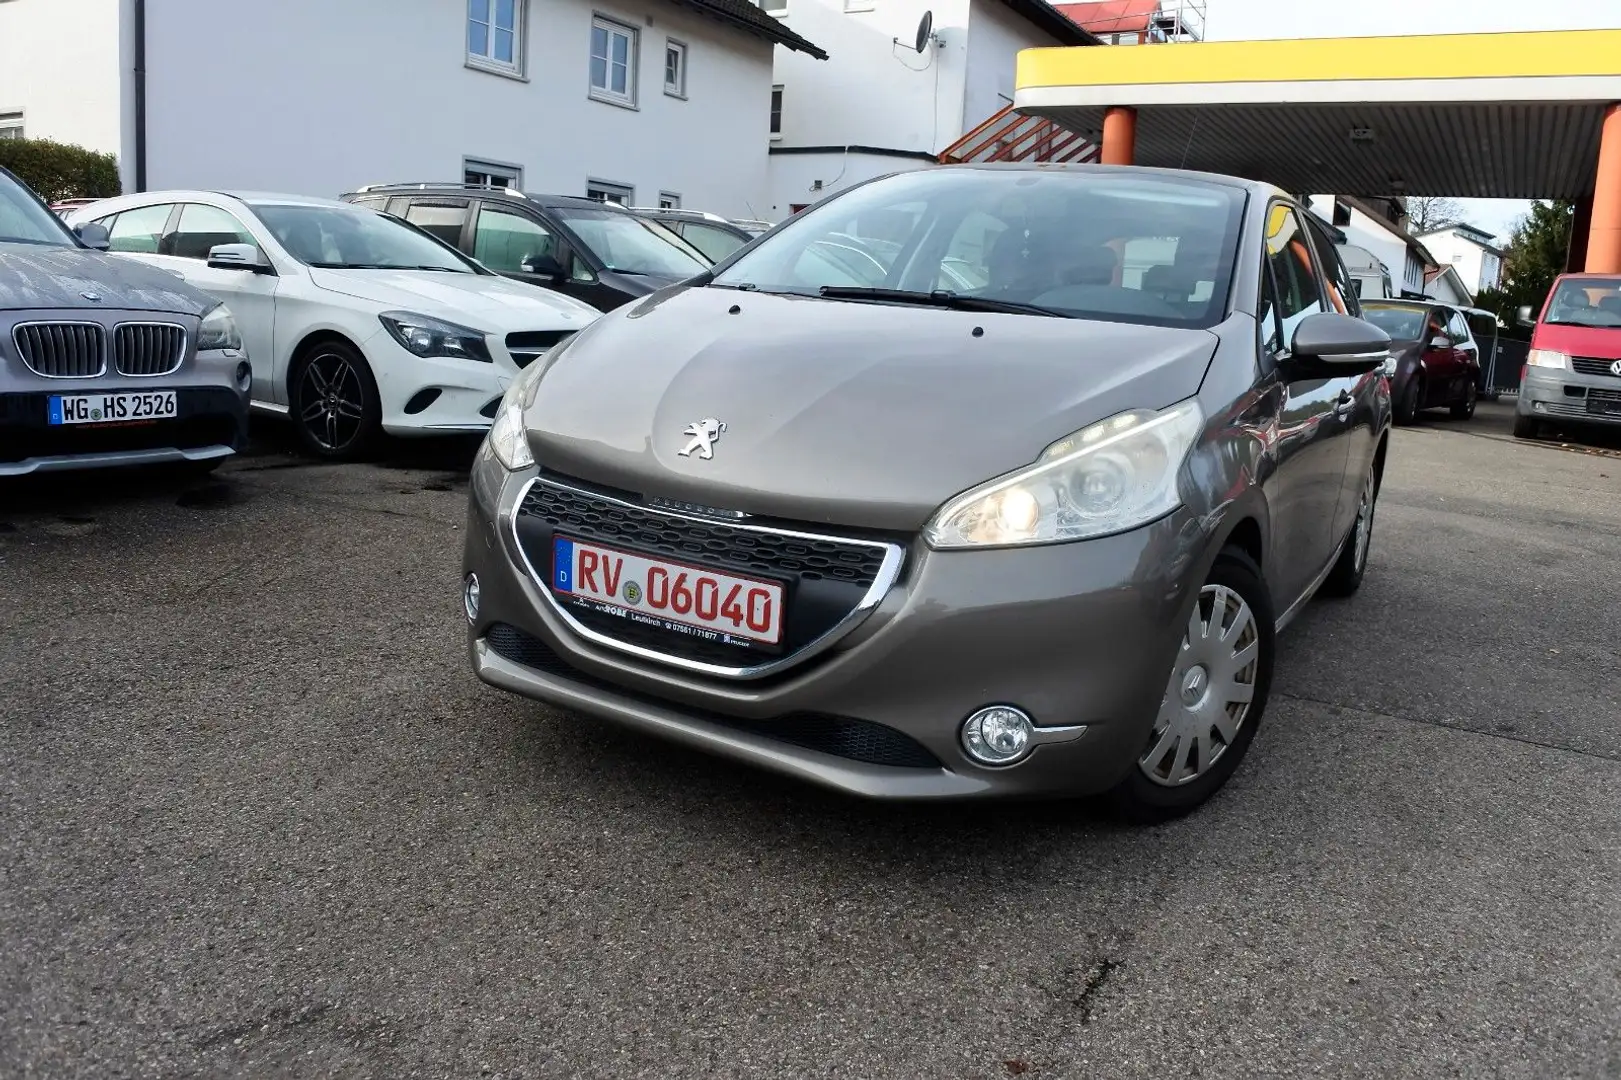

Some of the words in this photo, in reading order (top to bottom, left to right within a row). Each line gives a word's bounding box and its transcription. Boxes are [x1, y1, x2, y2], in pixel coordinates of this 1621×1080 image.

[63, 398, 89, 420] WG
[103, 397, 127, 418] HS
[132, 394, 174, 416] 2526
[560, 571, 567, 582] D
[578, 549, 623, 597] RV
[647, 566, 771, 633] 06040
[631, 613, 661, 627] Leutkirch
